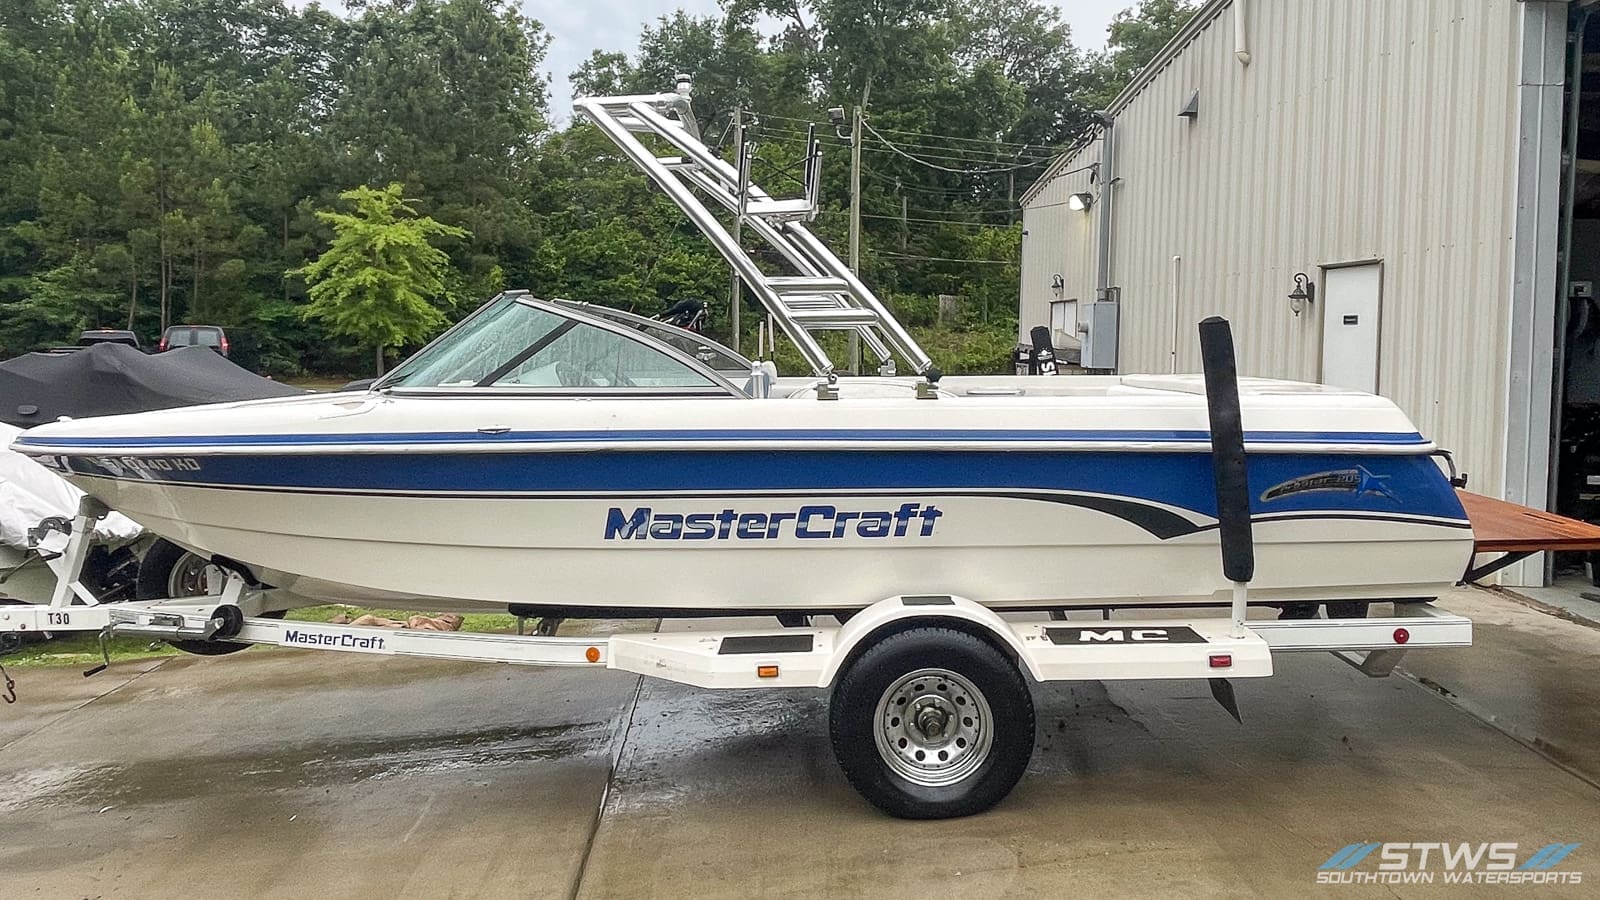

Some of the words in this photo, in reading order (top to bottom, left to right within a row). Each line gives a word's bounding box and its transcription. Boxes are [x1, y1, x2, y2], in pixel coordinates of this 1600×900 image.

[603, 503, 943, 540] MasterCraft
[47, 612, 70, 625] T30
[284, 629, 385, 650] MasterCraft
[1078, 630, 1169, 642] MC
